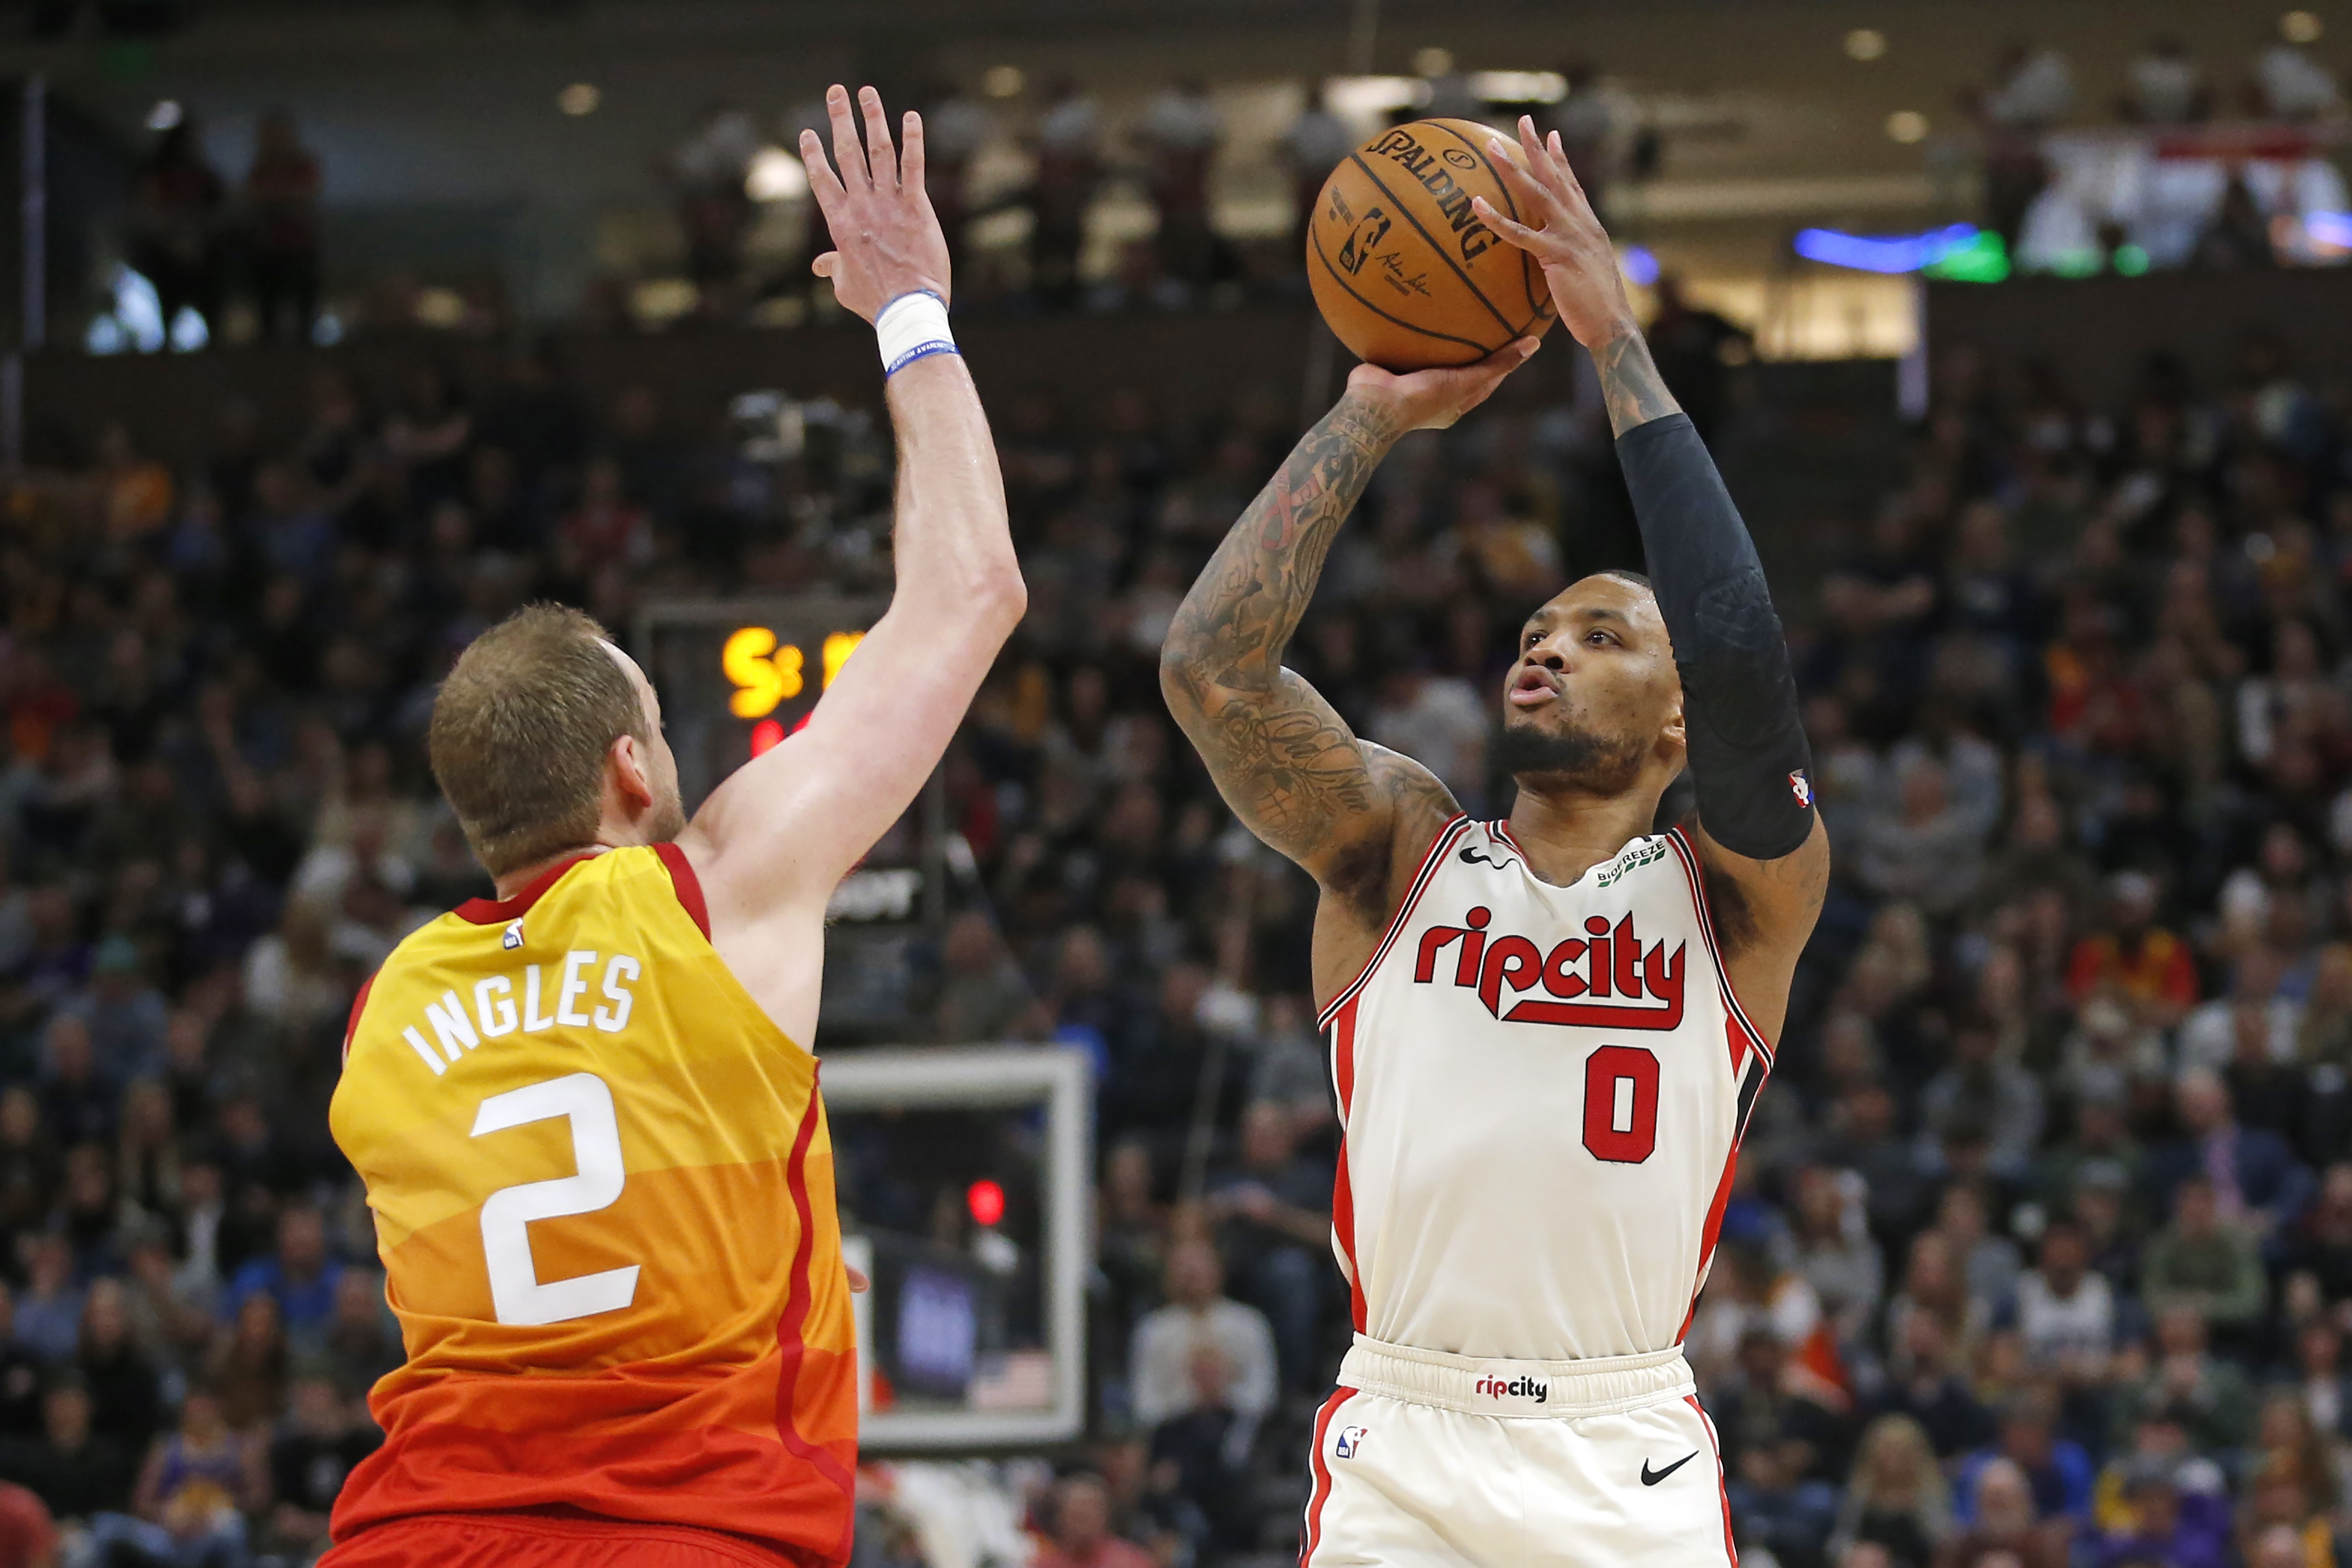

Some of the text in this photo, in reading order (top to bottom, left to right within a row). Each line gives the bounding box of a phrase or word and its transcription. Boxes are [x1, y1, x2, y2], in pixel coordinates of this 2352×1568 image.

[1366, 130, 1501, 261] SPALDING
[1597, 841, 1665, 881] BIOFREEZE
[402, 950, 641, 1076] INGLES
[1414, 906, 1686, 1031] ripcity
[1582, 1044, 1659, 1164] 0
[470, 1072, 640, 1326] 2
[1476, 1374, 1547, 1403] ripcity
